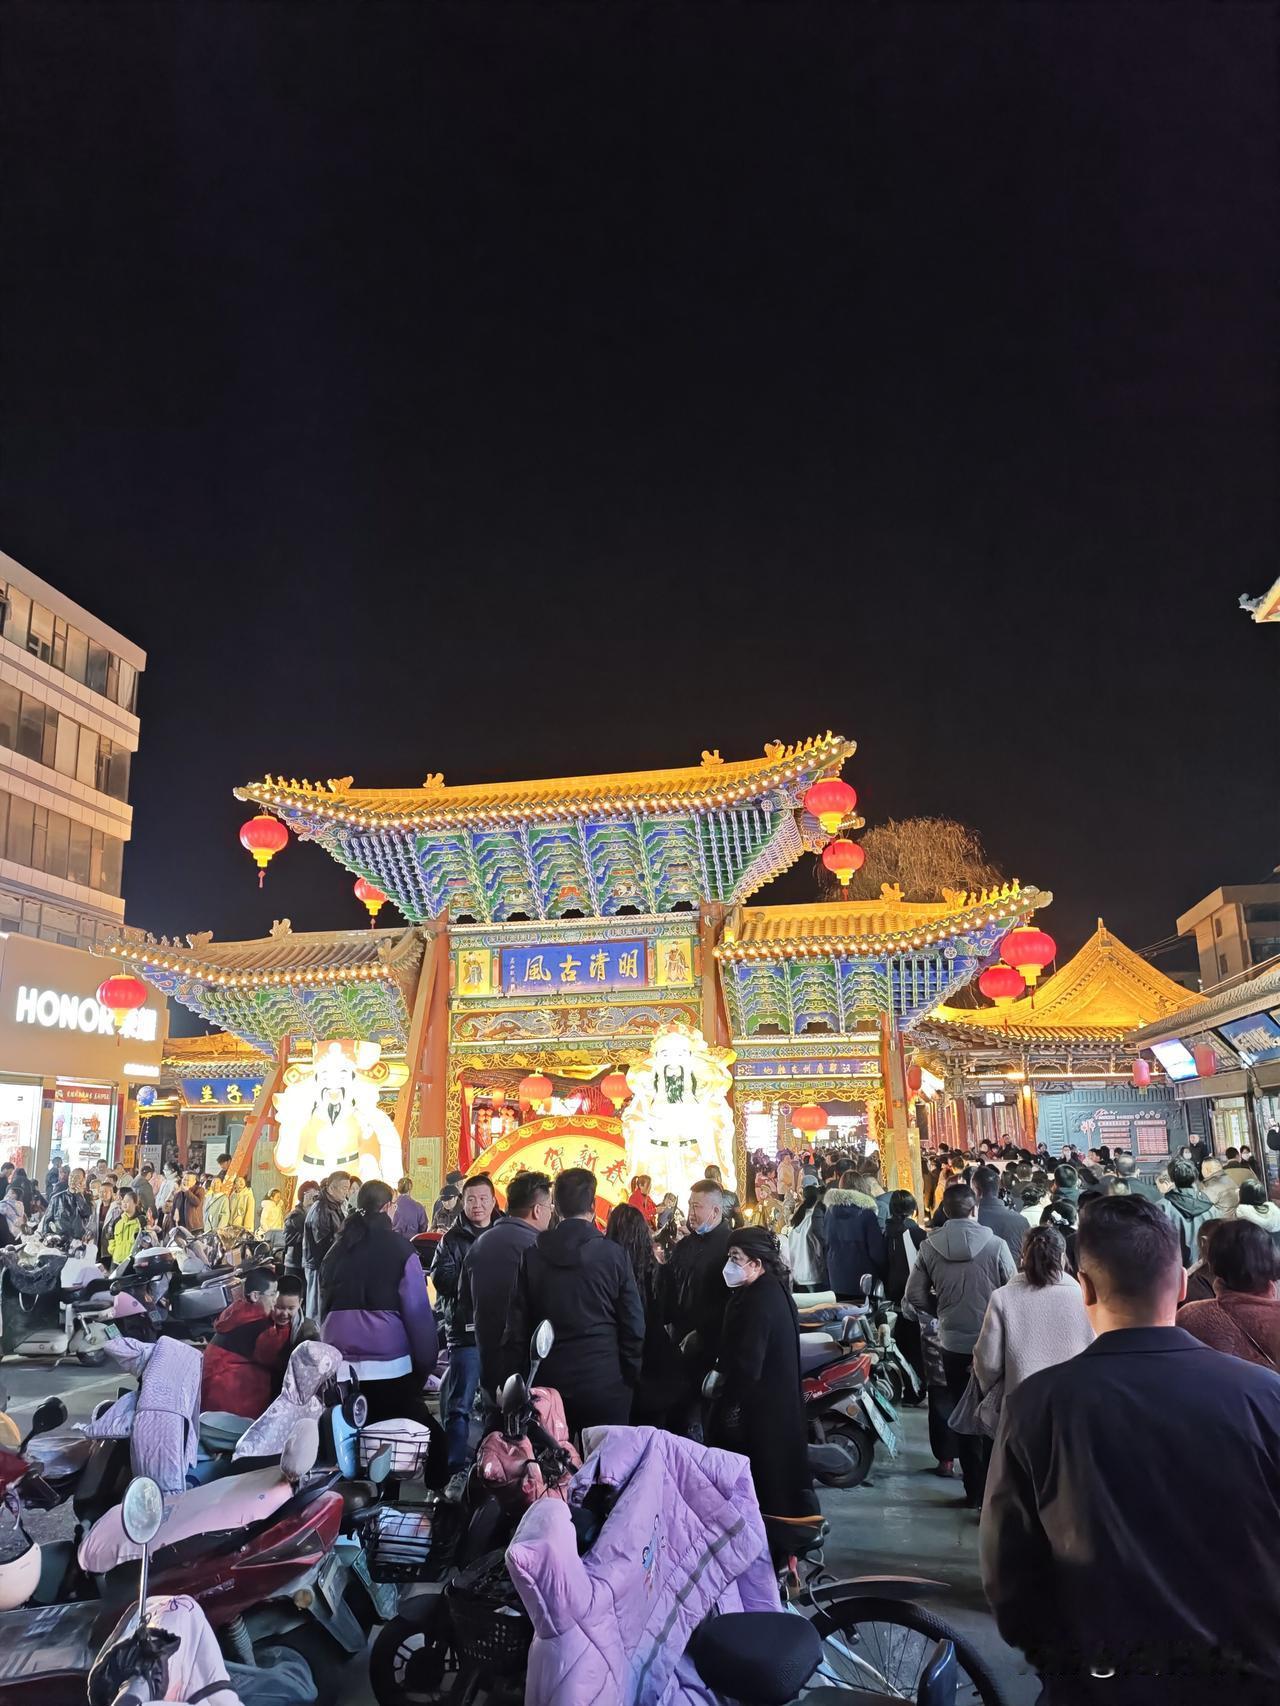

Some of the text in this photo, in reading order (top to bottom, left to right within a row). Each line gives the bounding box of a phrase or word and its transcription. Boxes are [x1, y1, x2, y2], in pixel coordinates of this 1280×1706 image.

[524, 949, 639, 982] 明清古風
[16, 986, 114, 1035] HONOR
